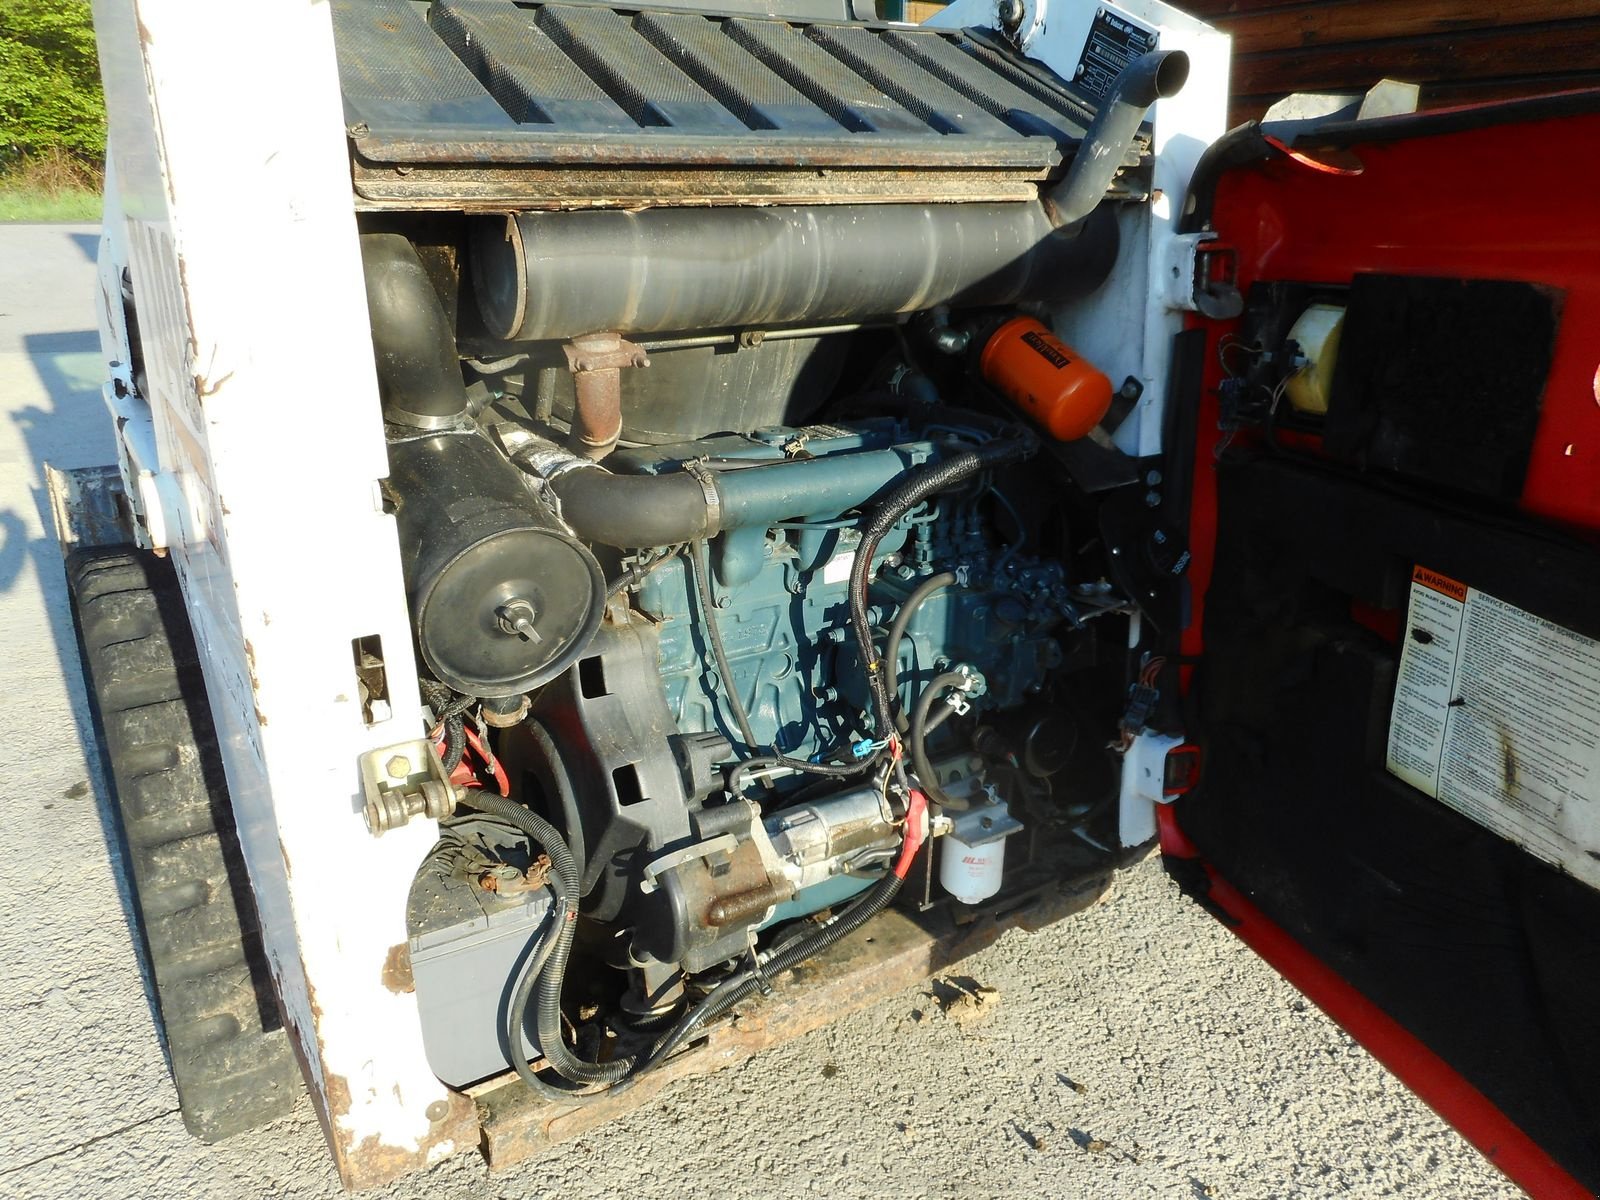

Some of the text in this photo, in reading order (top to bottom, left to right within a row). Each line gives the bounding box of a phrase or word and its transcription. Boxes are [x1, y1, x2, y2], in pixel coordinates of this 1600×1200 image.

[1423, 572, 1464, 597] WARNING
[1446, 602, 1460, 612] DEATH
[1478, 593, 1503, 609] SERVICE
[1503, 604, 1540, 625] CHECKLIST
[1540, 619, 1555, 632] AND
[1556, 626, 1596, 648] SCHEDULE
